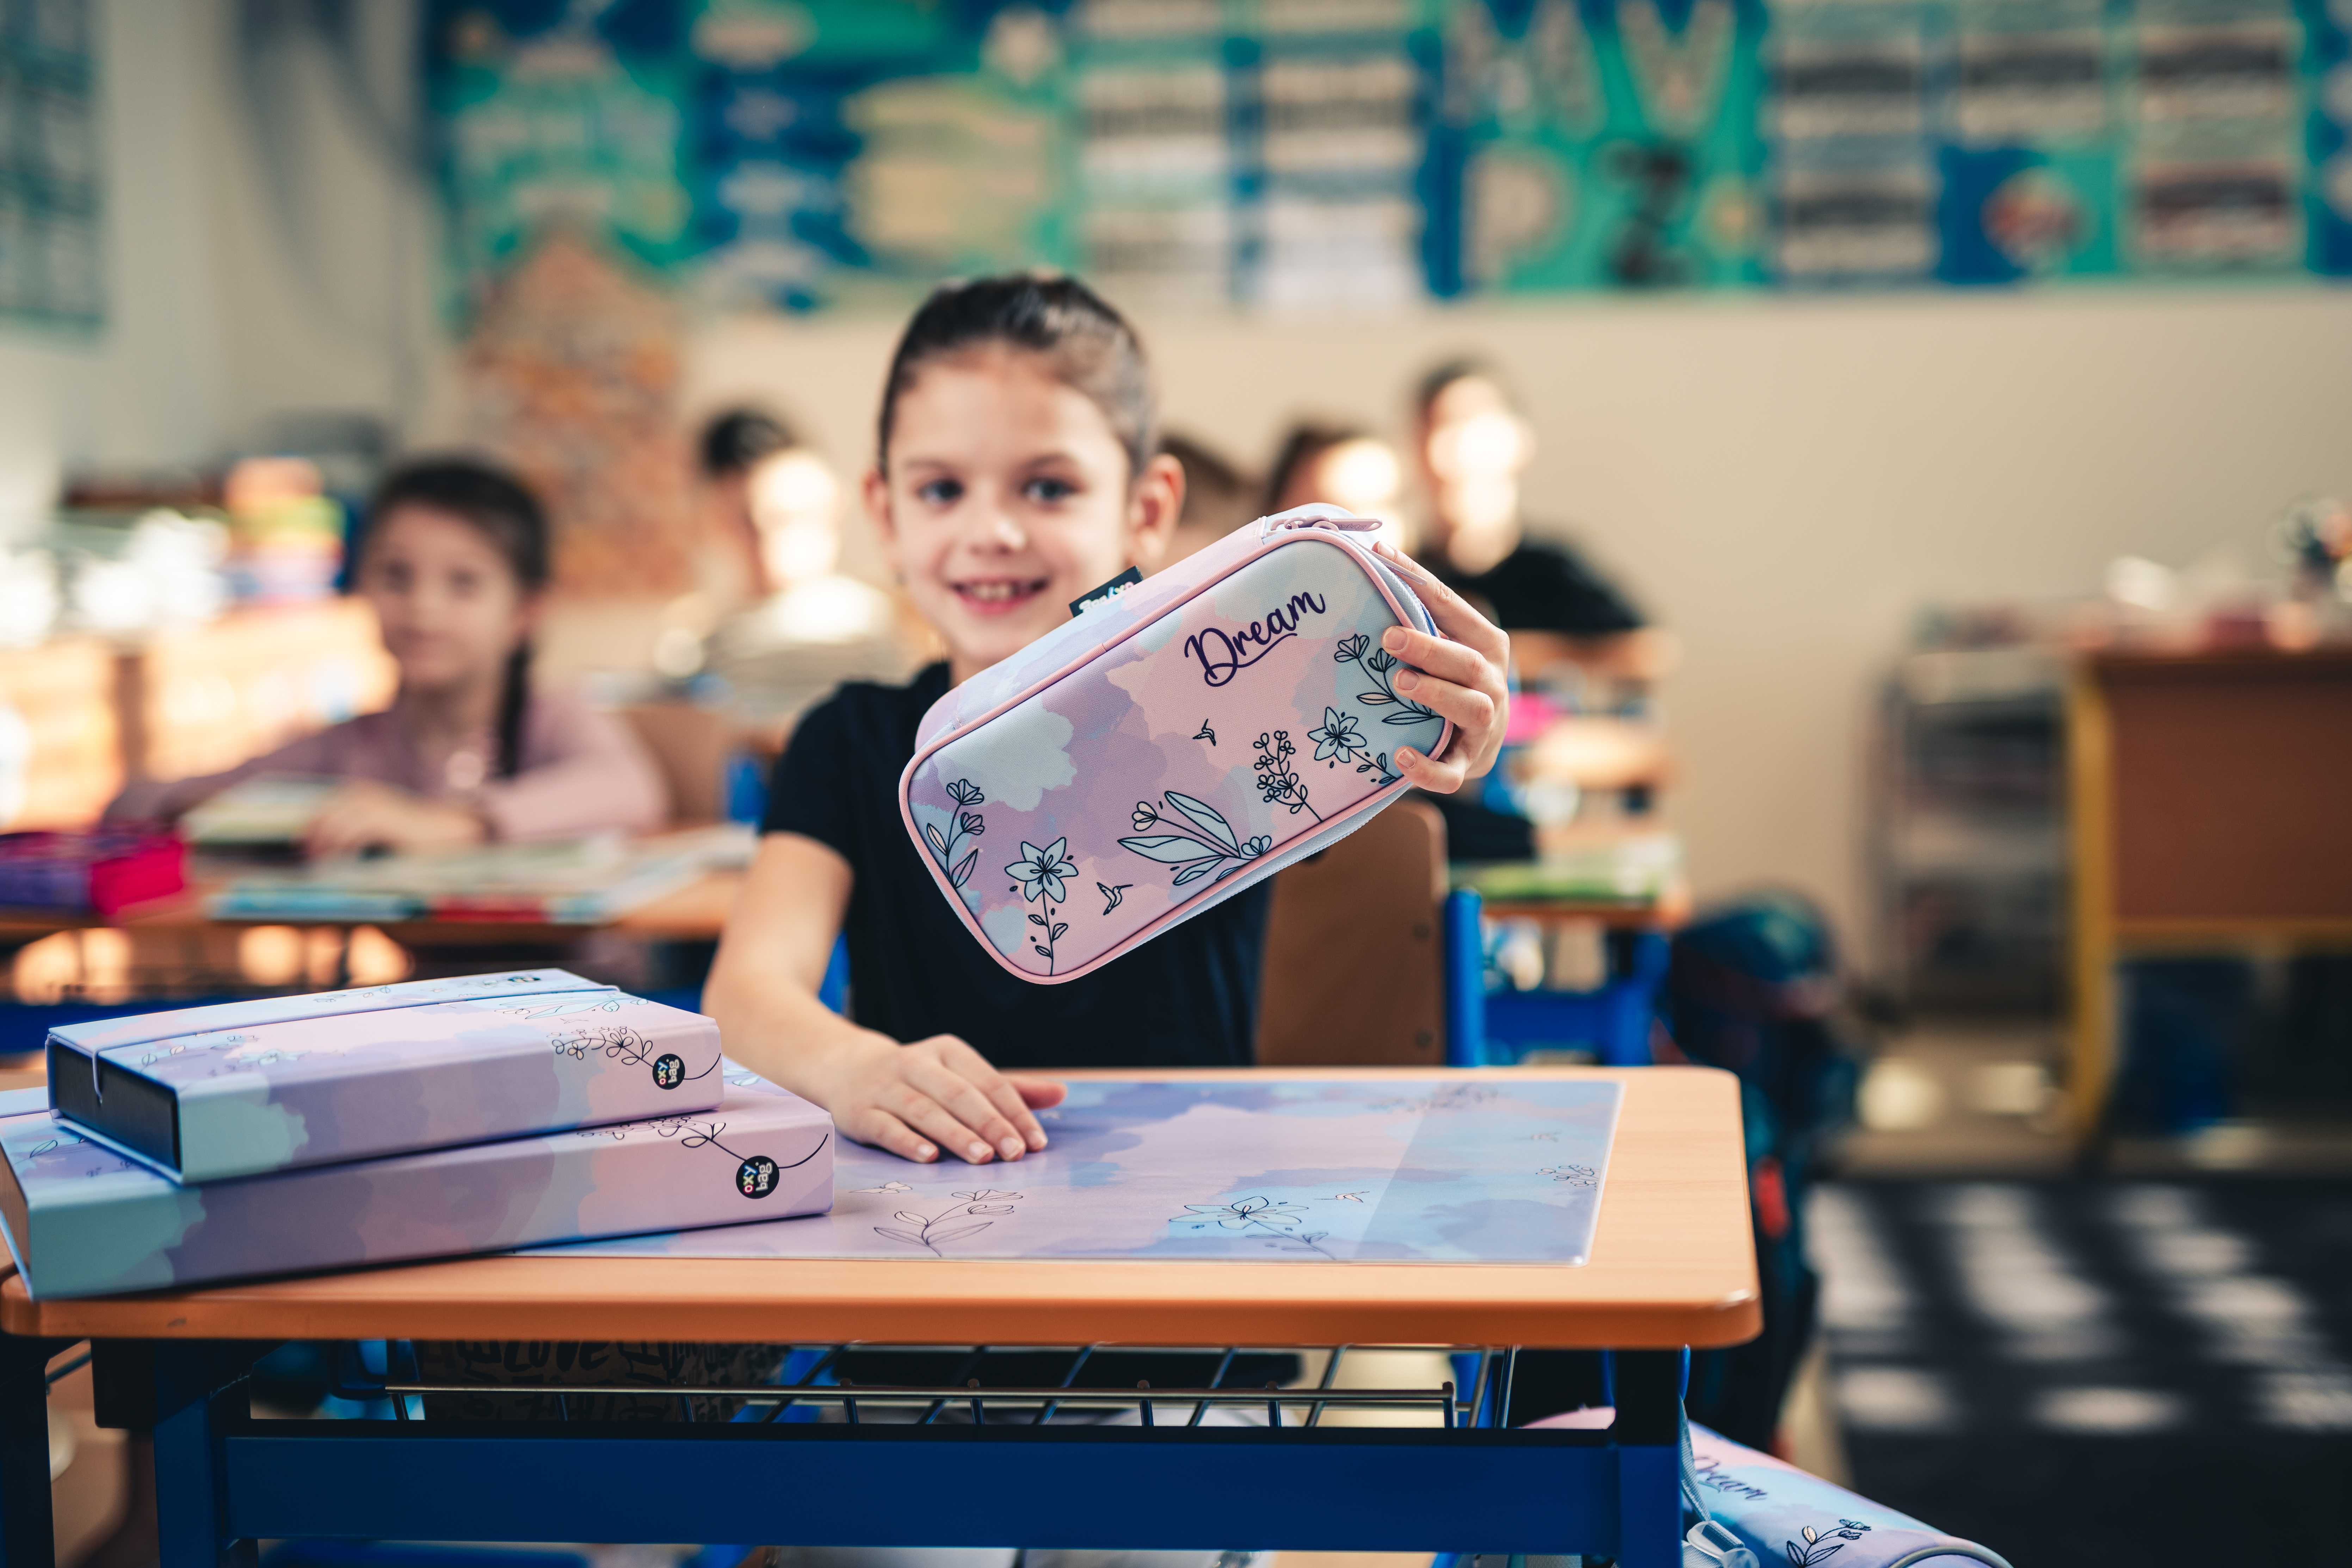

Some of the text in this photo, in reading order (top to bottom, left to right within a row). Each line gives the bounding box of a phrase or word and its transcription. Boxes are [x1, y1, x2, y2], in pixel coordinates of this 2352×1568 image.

[1184, 591, 1326, 687] Dream
[667, 1058, 680, 1084] bag
[755, 1162, 773, 1192] bag
